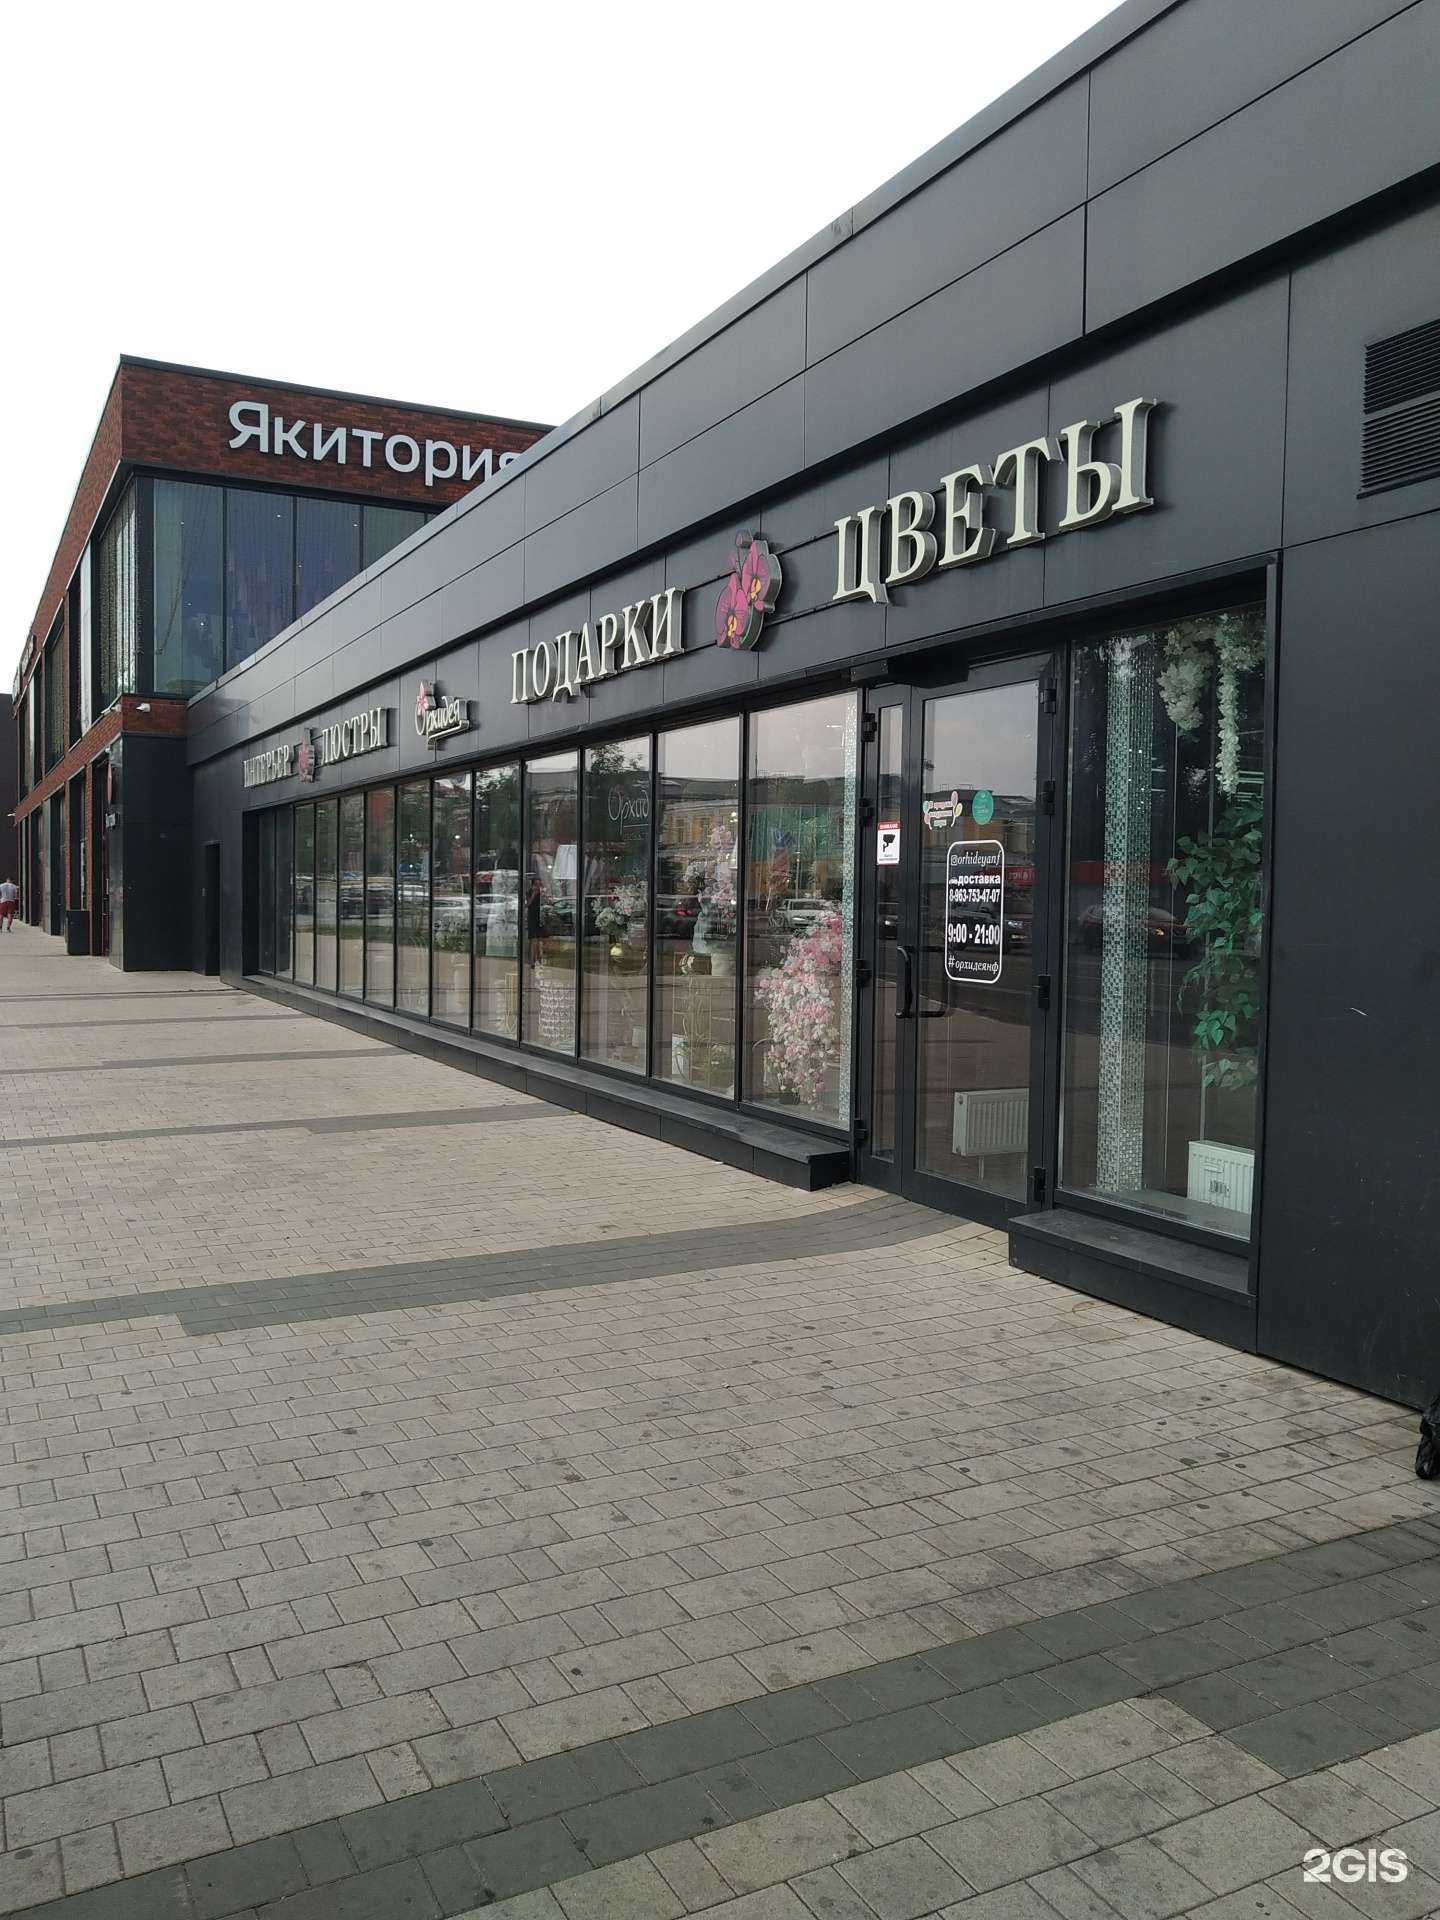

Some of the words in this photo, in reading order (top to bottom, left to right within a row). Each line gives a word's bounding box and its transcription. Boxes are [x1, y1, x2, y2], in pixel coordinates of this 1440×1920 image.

[833, 396, 1157, 604] ЦВЕТЫ
[510, 586, 686, 704] ПОДАРКИ
[415, 695, 464, 738] Орхидея
[243, 744, 291, 788] ИНТЕРЬЕР
[320, 707, 390, 767] ЛЮСТРЫ
[608, 785, 649, 836] Орхид
[949, 888, 1001, 903] 8-963-753-47-07
[957, 874, 1001, 887] доставка
[948, 923, 967, 943] 9:00
[974, 923, 1000, 945] 21:00
